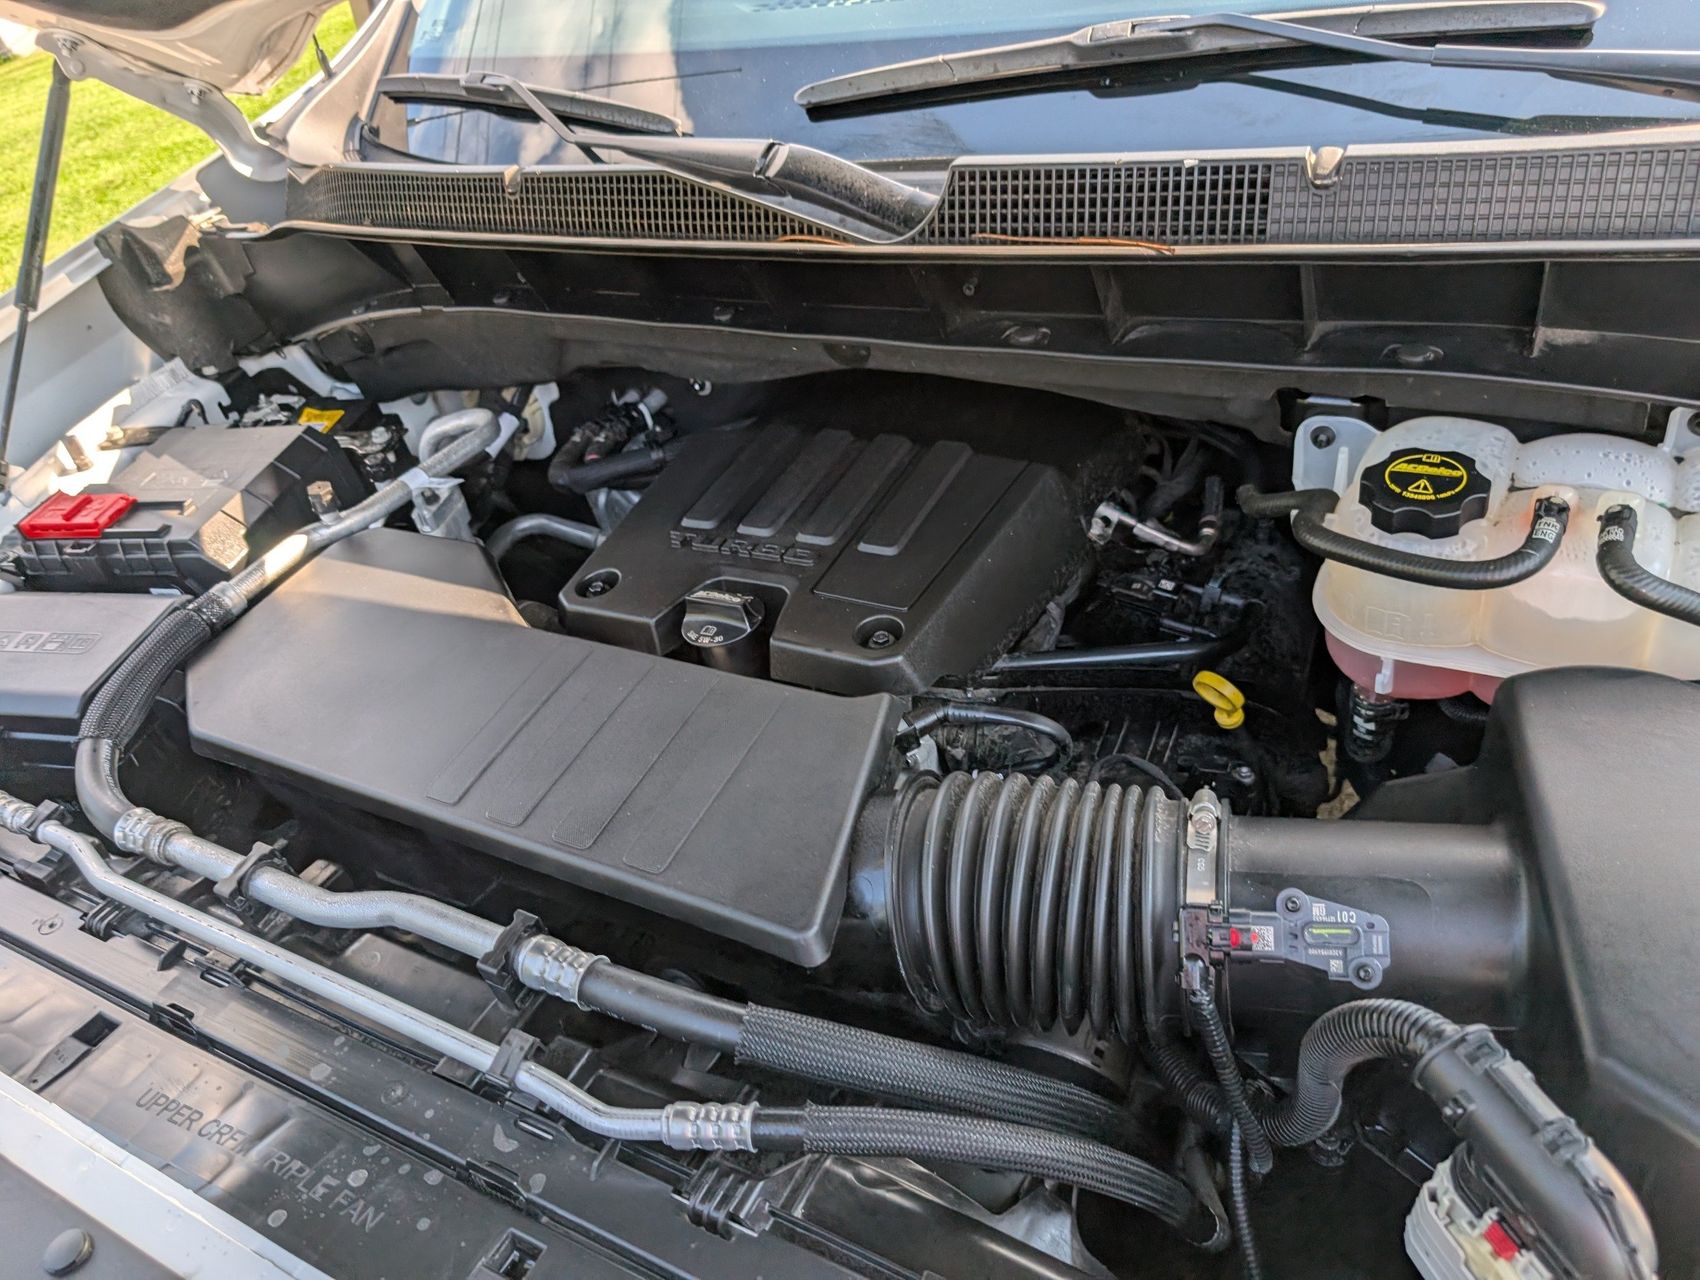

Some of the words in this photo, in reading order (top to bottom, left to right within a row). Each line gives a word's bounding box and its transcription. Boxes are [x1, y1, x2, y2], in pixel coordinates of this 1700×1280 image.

[1312, 903, 1326, 916] GM
[135, 1088, 205, 1132] UPPER
[328, 1188, 386, 1233] FAN
